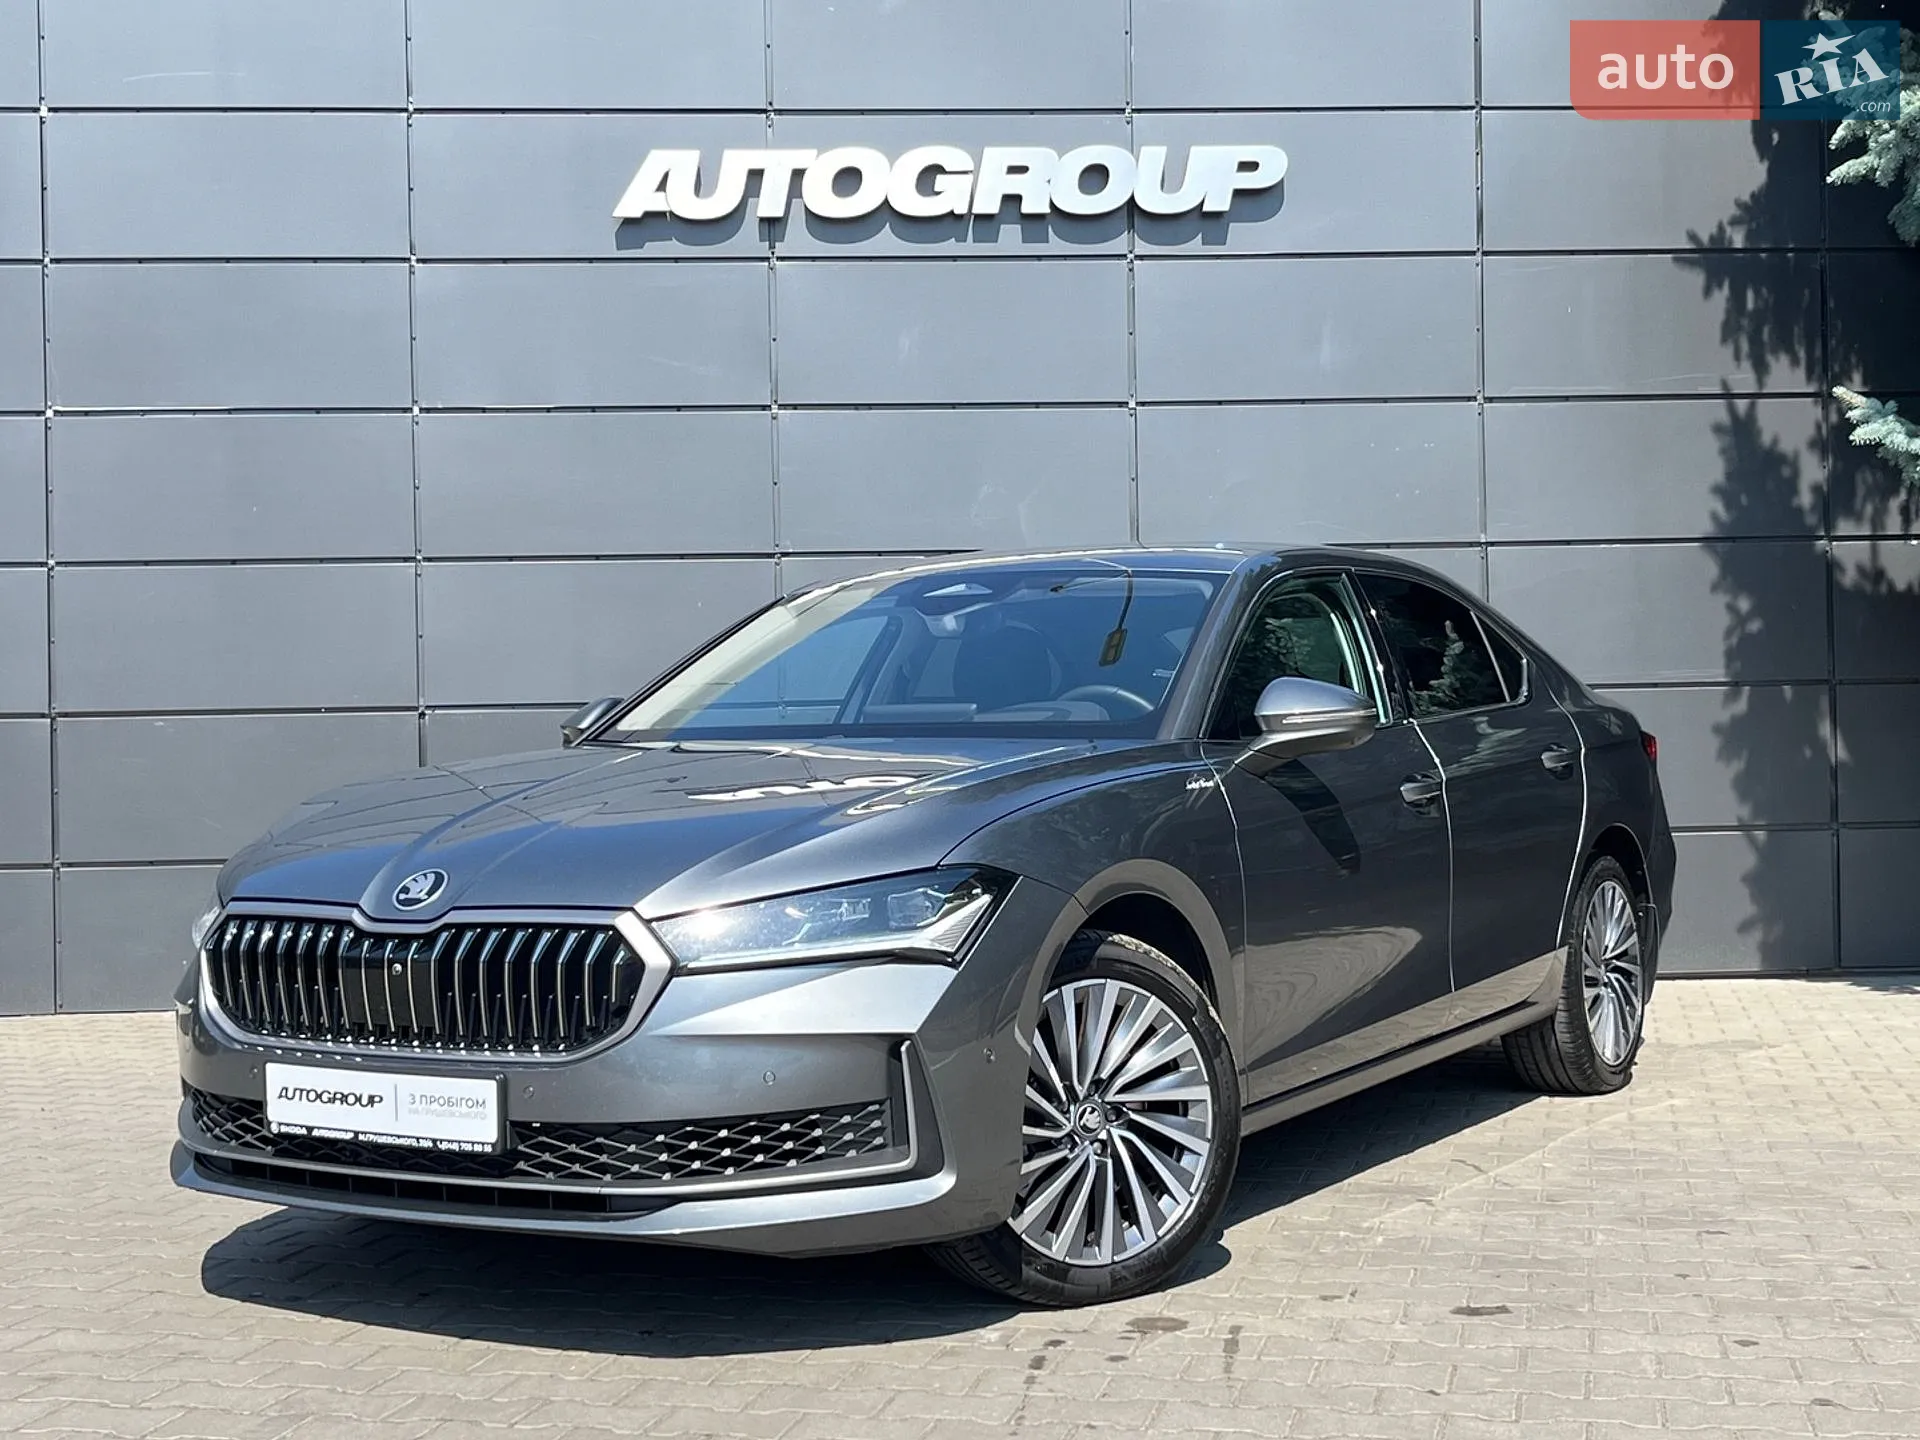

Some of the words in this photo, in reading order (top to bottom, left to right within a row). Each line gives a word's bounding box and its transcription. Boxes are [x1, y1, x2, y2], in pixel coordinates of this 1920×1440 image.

[612, 144, 1289, 222] AUTOGROUP
[277, 1086, 384, 1108] AUTOGROUP
[419, 1094, 487, 1110] ПРОБІГОМ
